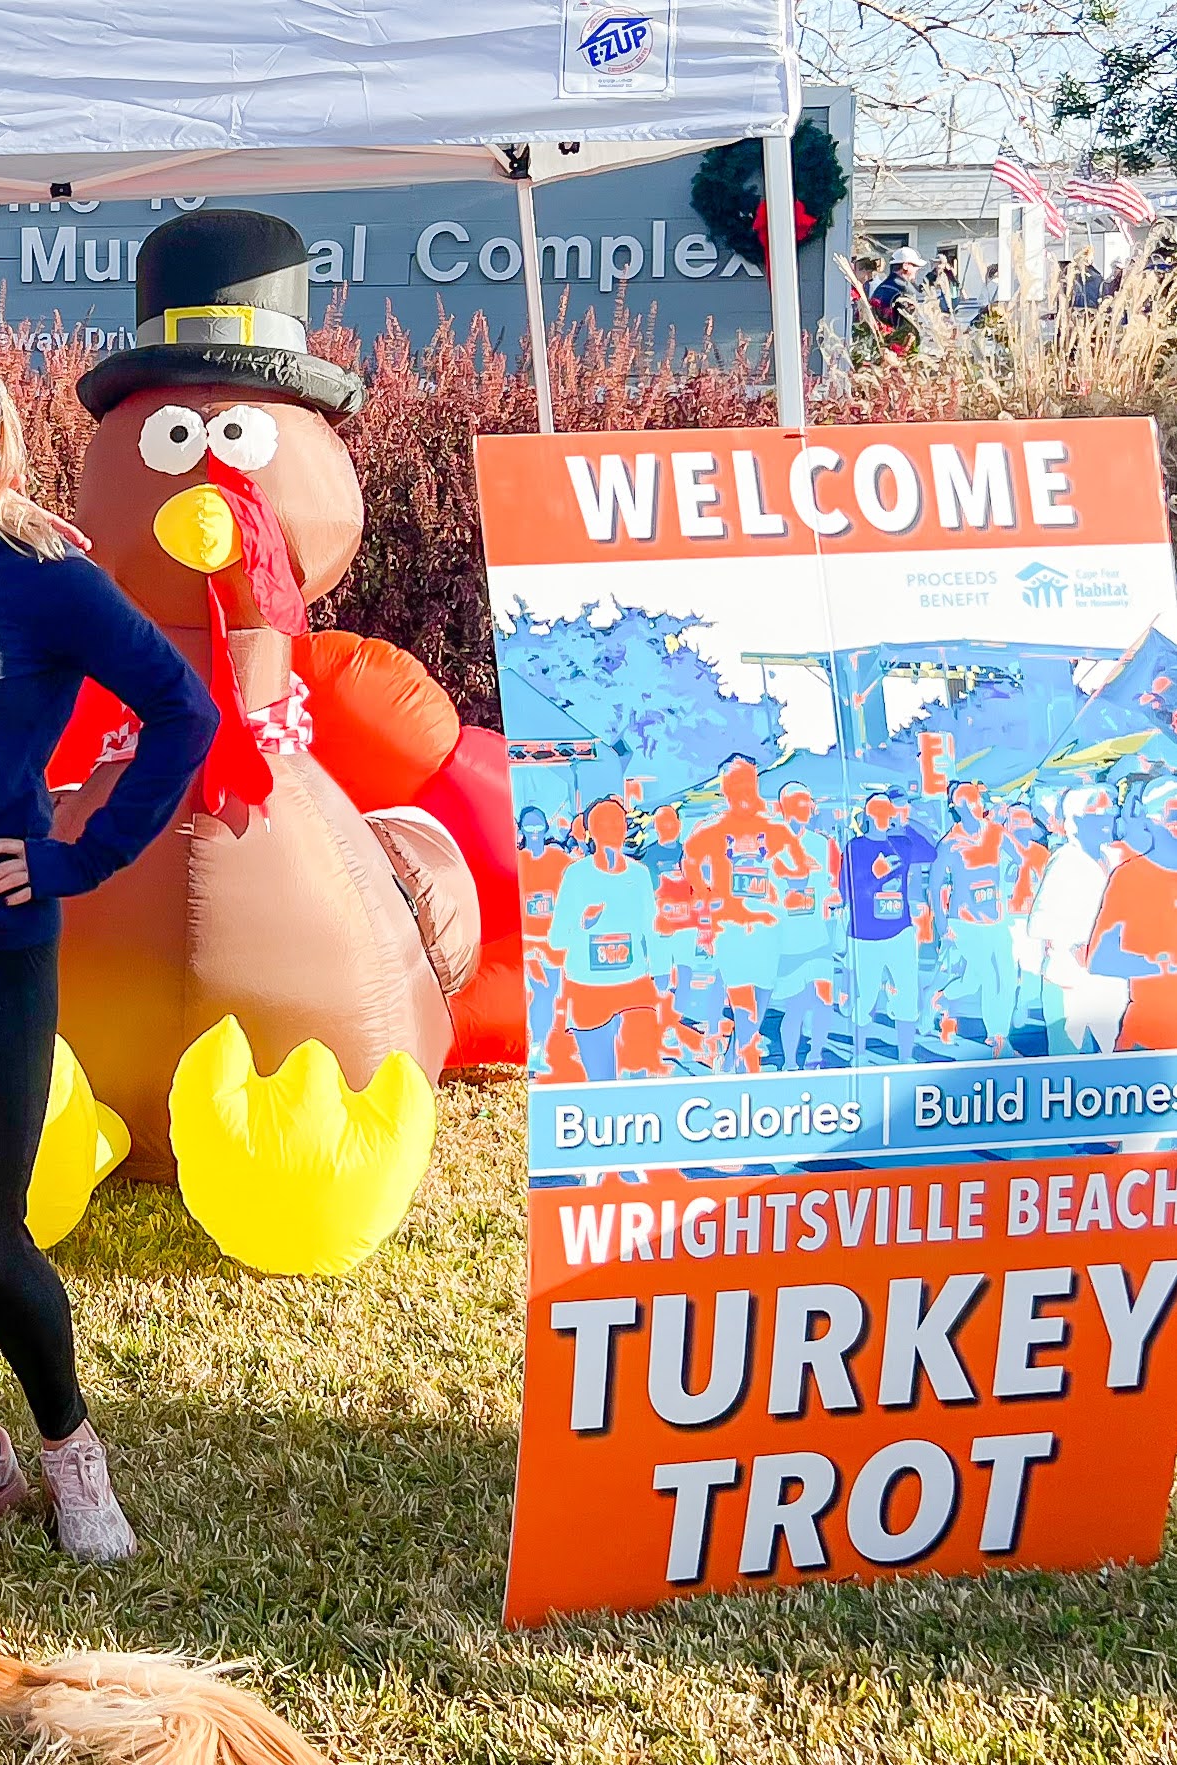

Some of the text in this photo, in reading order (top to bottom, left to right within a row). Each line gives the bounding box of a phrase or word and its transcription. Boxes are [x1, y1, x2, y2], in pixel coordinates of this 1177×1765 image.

[564, 440, 1076, 542] WELCOME
[906, 570, 998, 587] PROCEEDS
[919, 592, 990, 608] BENEFIT
[1073, 582, 1129, 597] Habitat
[554, 1076, 1177, 1149] Burn Calories Build Home
[559, 1179, 984, 1265] WRIGHTSVILLE
[550, 1259, 1177, 1434] TURKEY
[652, 1431, 1055, 1583] TROT
